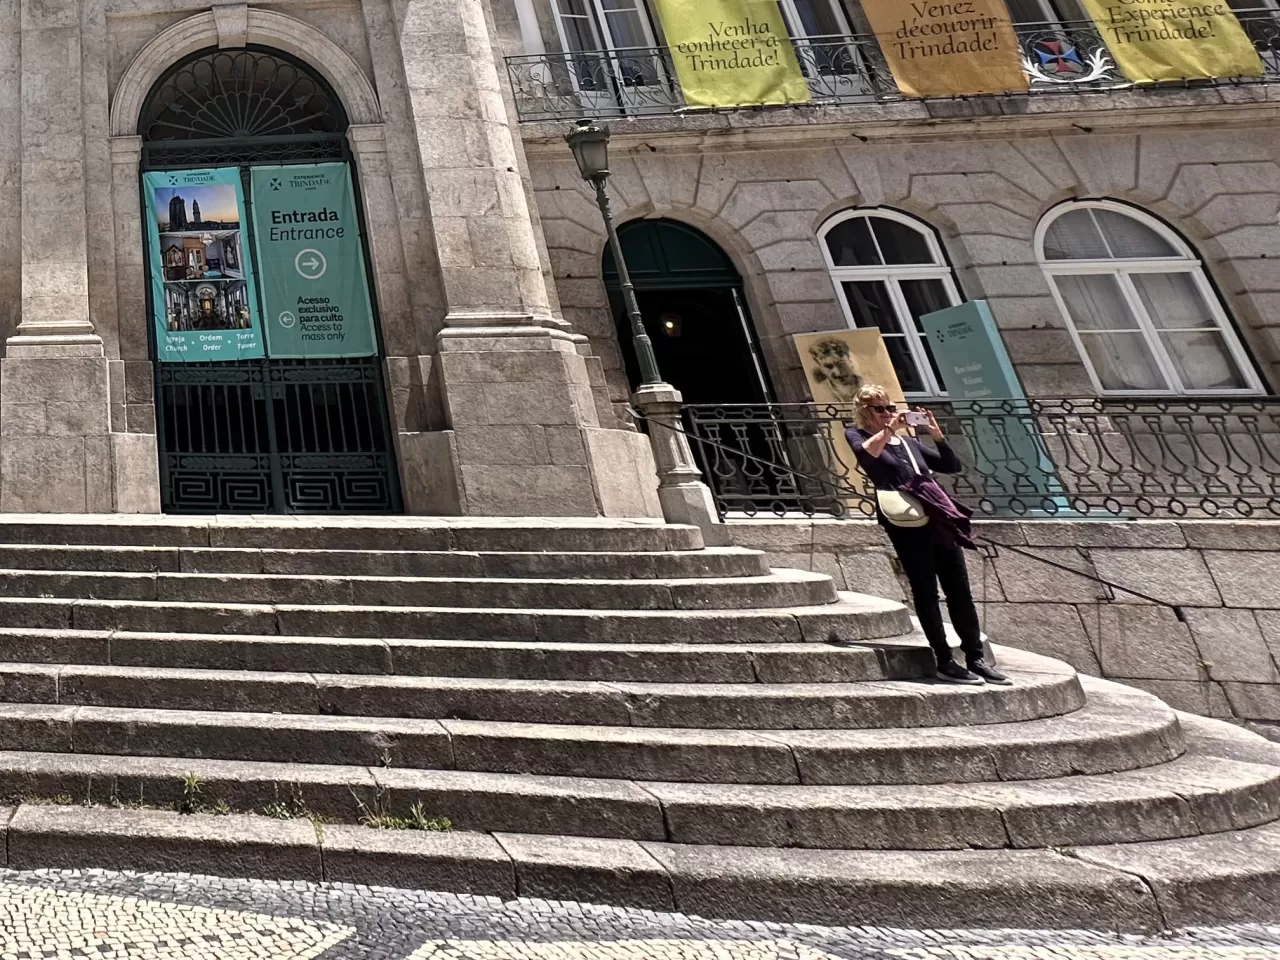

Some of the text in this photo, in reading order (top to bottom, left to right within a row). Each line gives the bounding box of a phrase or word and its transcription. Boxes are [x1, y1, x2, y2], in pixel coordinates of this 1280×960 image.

[910, 1, 975, 19] Venez
[1107, 3, 1227, 27] Experience
[708, 17, 771, 37] Venha
[896, 12, 997, 39] découvrir
[1107, 20, 1216, 44] Trindade!
[677, 34, 780, 54] conhecer a
[893, 32, 999, 60] Trindade!
[686, 49, 780, 71] Trindade!
[183, 175, 216, 184] TRINDADE
[289, 178, 332, 189] TRINDADE
[272, 208, 340, 225] Entrada
[270, 226, 345, 241] Entrance
[297, 296, 330, 305] Acesso
[298, 304, 340, 314] exclusivo
[299, 313, 344, 325] para culto
[300, 322, 343, 332] Access to
[165, 335, 186, 344] Igreja
[199, 334, 223, 342] Ordem
[301, 332, 346, 342] mass only
[165, 344, 188, 352] Church
